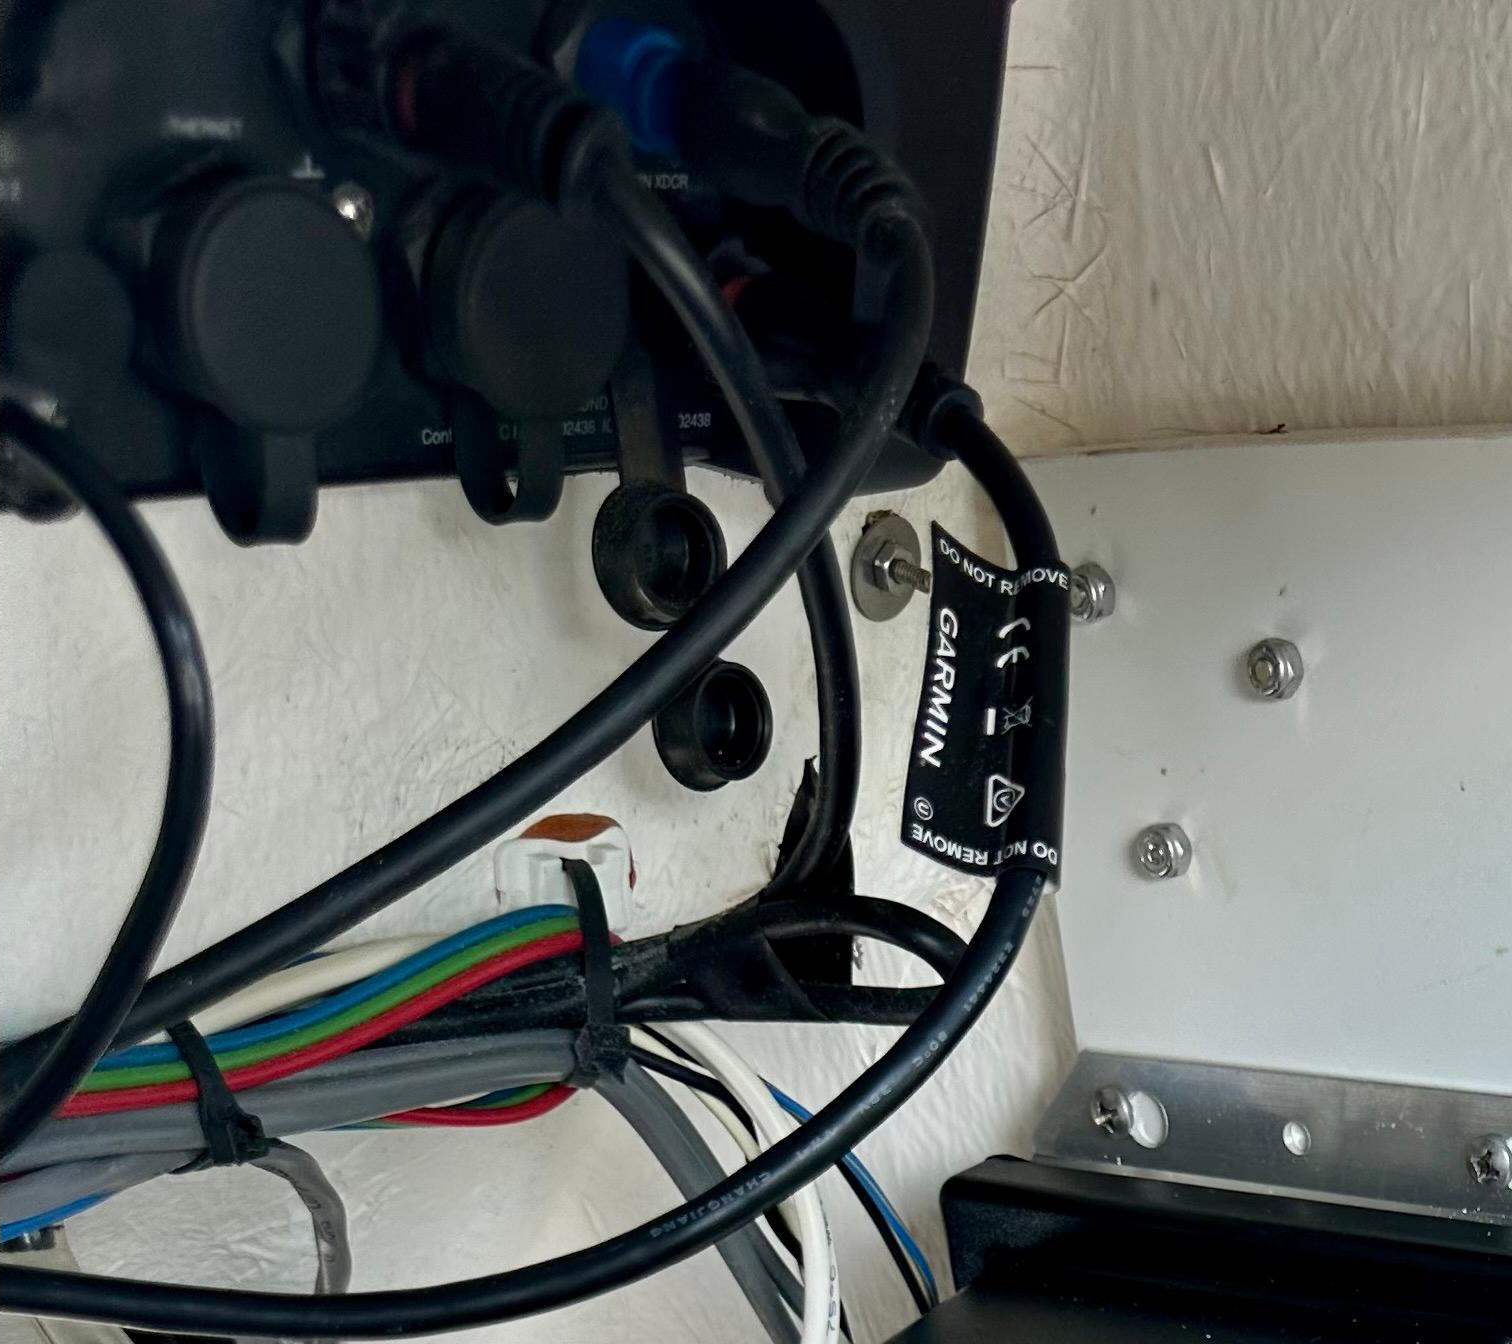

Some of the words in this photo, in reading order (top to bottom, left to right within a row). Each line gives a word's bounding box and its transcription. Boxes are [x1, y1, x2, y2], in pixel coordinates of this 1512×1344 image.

[939, 538, 961, 564] DO
[962, 559, 996, 589] NOT
[999, 567, 1070, 597] REMOVE
[919, 607, 958, 768] GARMIN
[911, 823, 988, 867] REMOVE
[993, 840, 1028, 866] NOT
[1033, 841, 1058, 865] DO
